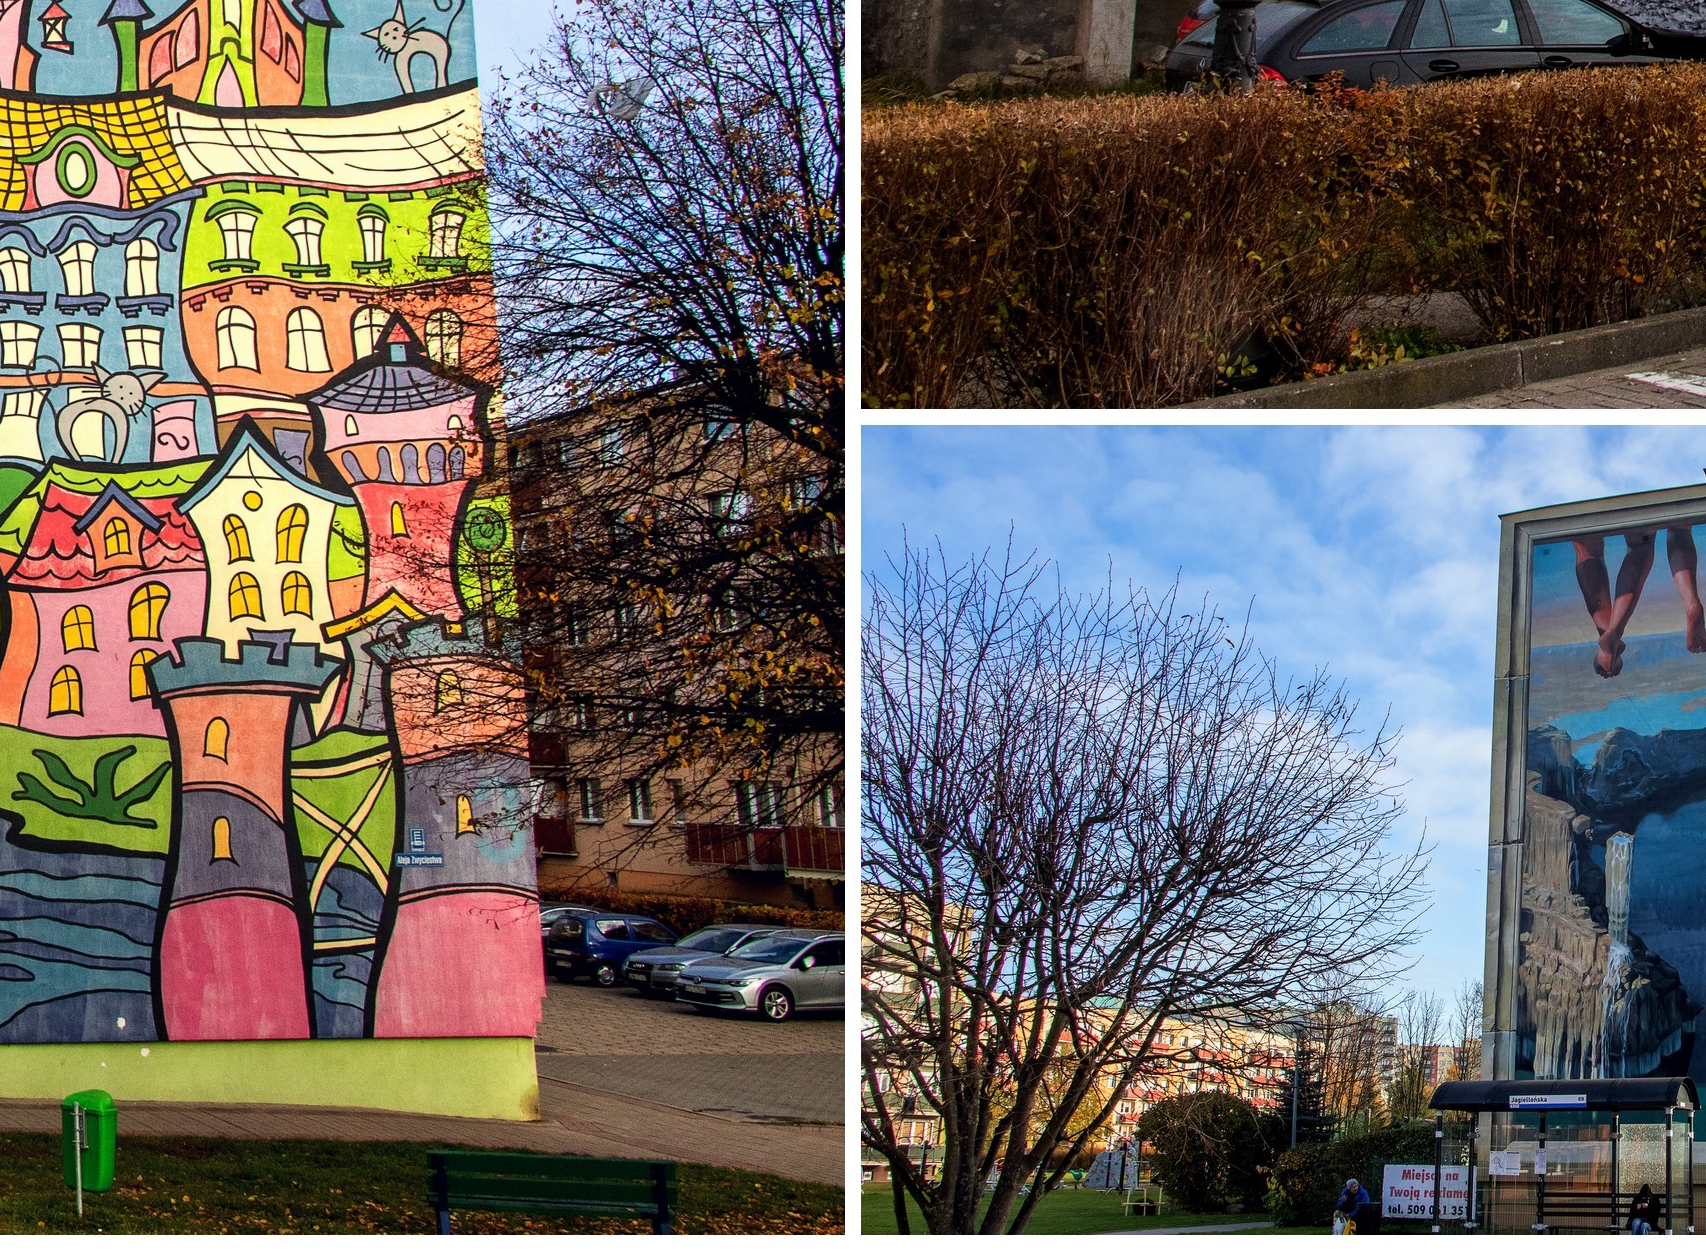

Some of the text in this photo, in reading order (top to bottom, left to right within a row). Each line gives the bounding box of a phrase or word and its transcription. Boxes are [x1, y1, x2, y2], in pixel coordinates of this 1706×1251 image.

[397, 856, 411, 865] Aleja
[1402, 1169, 1459, 1183] Miejsc na
[1390, 1186, 1468, 1202] Twoją relamę
[1388, 1204, 1404, 1214] tel.
[1407, 1204, 1426, 1214] 509
[1428, 1204, 1447, 1215] 01
